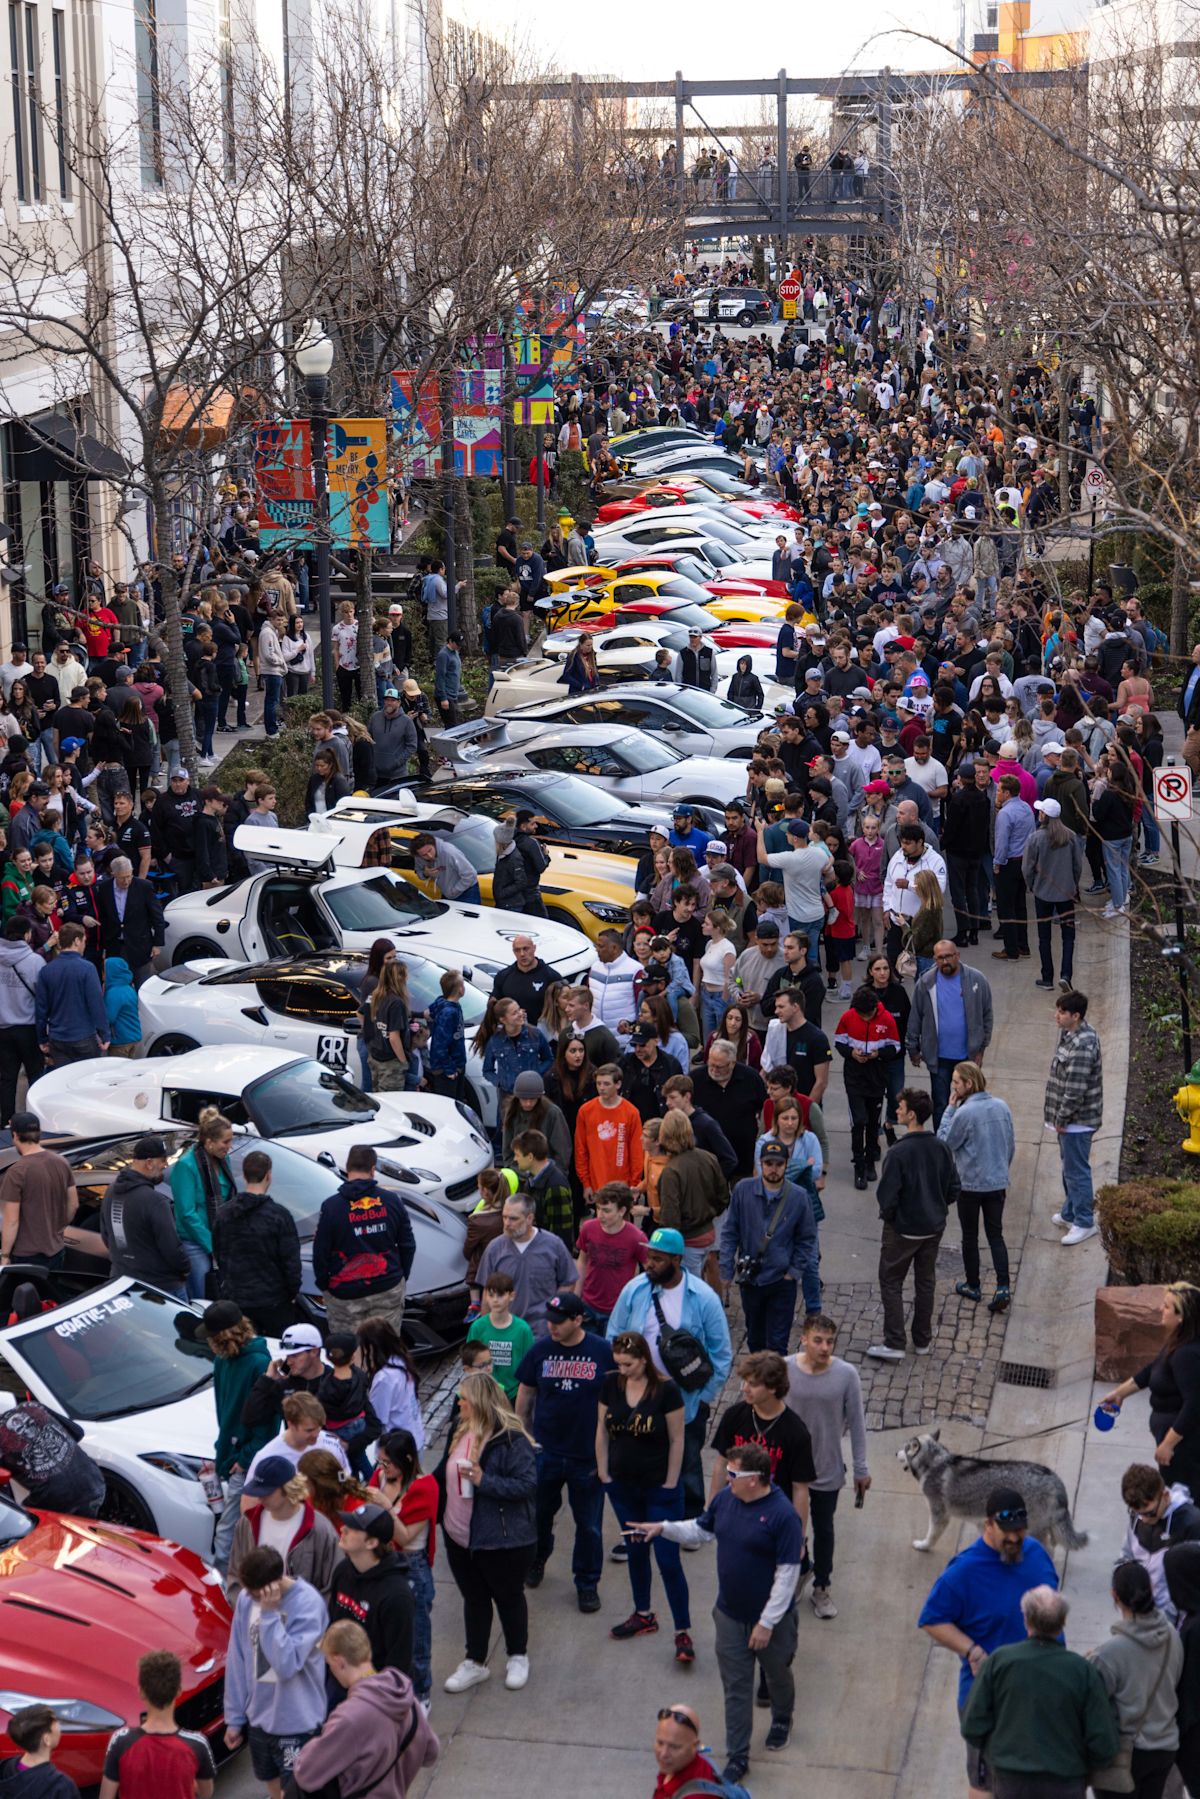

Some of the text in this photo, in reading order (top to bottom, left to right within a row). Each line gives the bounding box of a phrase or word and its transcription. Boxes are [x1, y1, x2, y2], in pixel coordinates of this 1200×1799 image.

[780, 286, 799, 295] STOP
[350, 452, 359, 461] BE
[348, 1207, 388, 1223] Red Bull
[489, 1341, 511, 1349] NINJA
[542, 1360, 597, 1380] YANKEES
